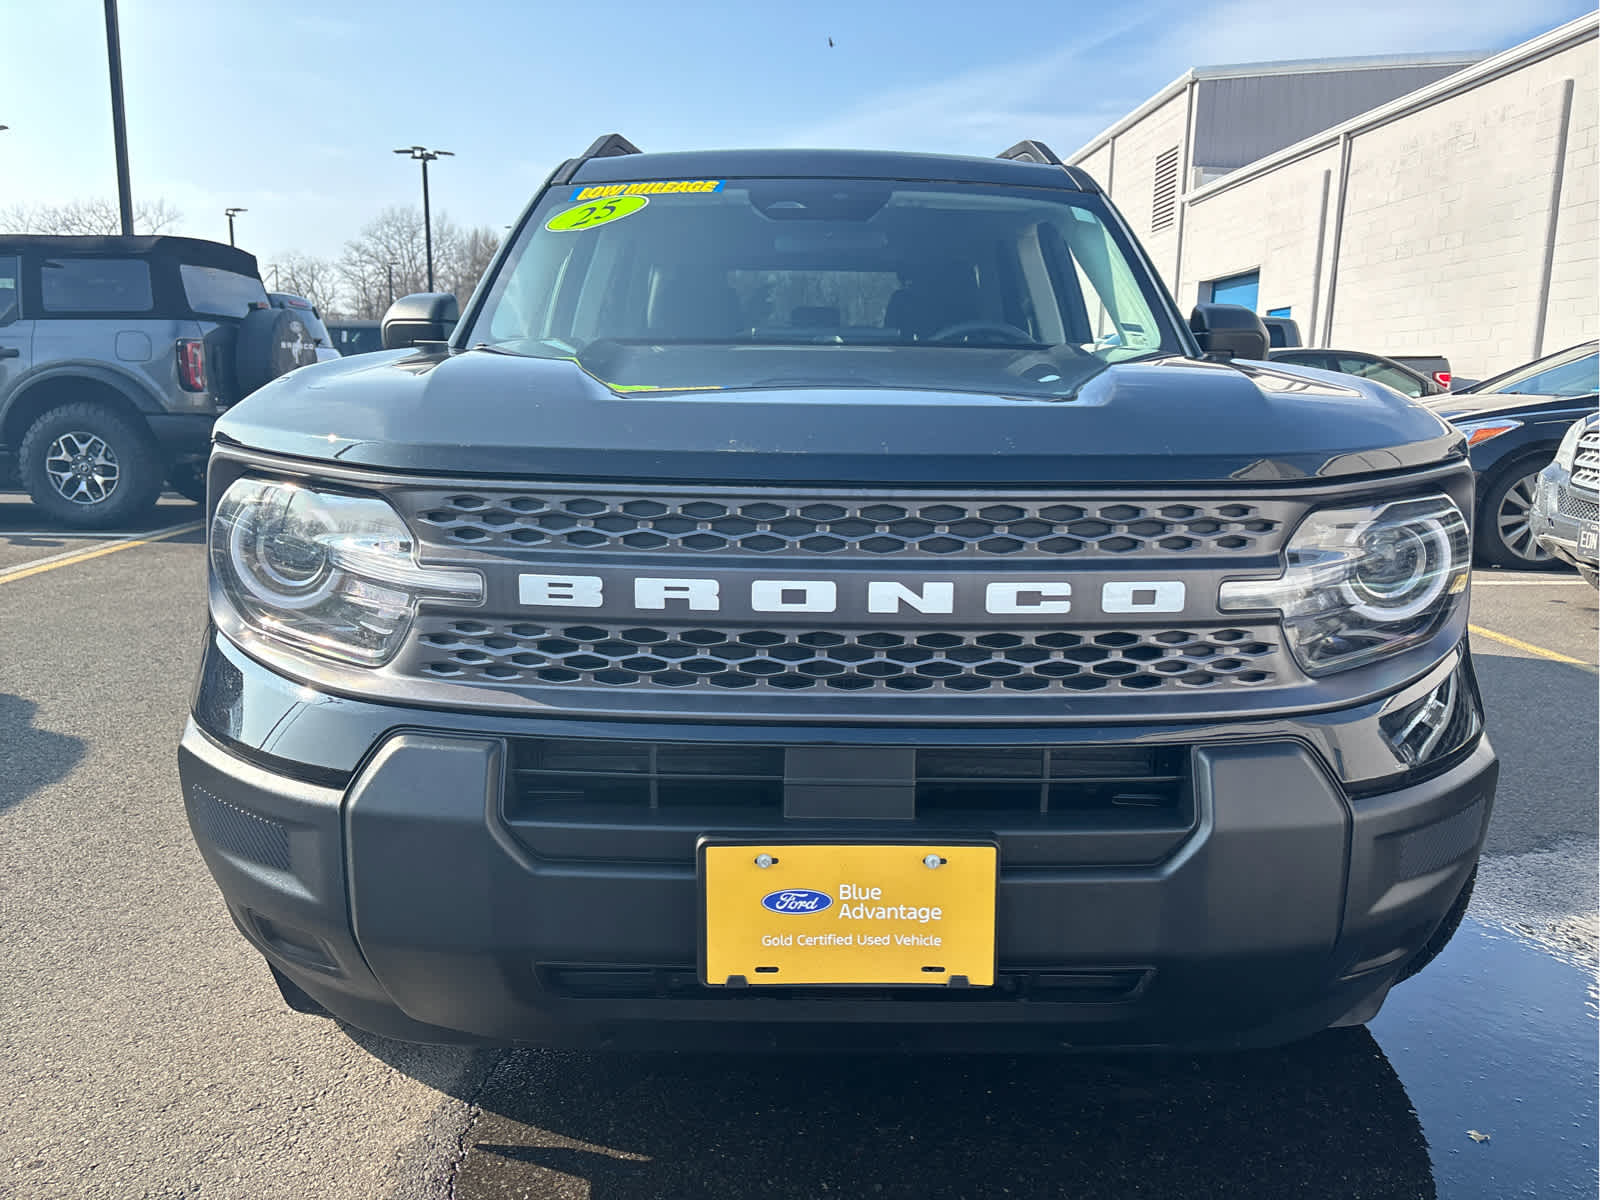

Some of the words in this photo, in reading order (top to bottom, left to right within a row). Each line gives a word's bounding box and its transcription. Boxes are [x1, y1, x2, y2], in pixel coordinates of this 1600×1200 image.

[577, 184, 627, 199] LOW
[623, 181, 720, 195] MILEAGE
[570, 199, 623, 228] 25
[280, 341, 314, 350] BRCO
[519, 573, 1186, 614] BRONCO
[839, 883, 882, 900] Blue
[775, 892, 820, 910] Ford
[838, 903, 942, 923] Advantage
[761, 934, 793, 947] Gold
[796, 933, 853, 946] Certified
[857, 933, 890, 946] Used
[894, 933, 942, 947] Vehicle
